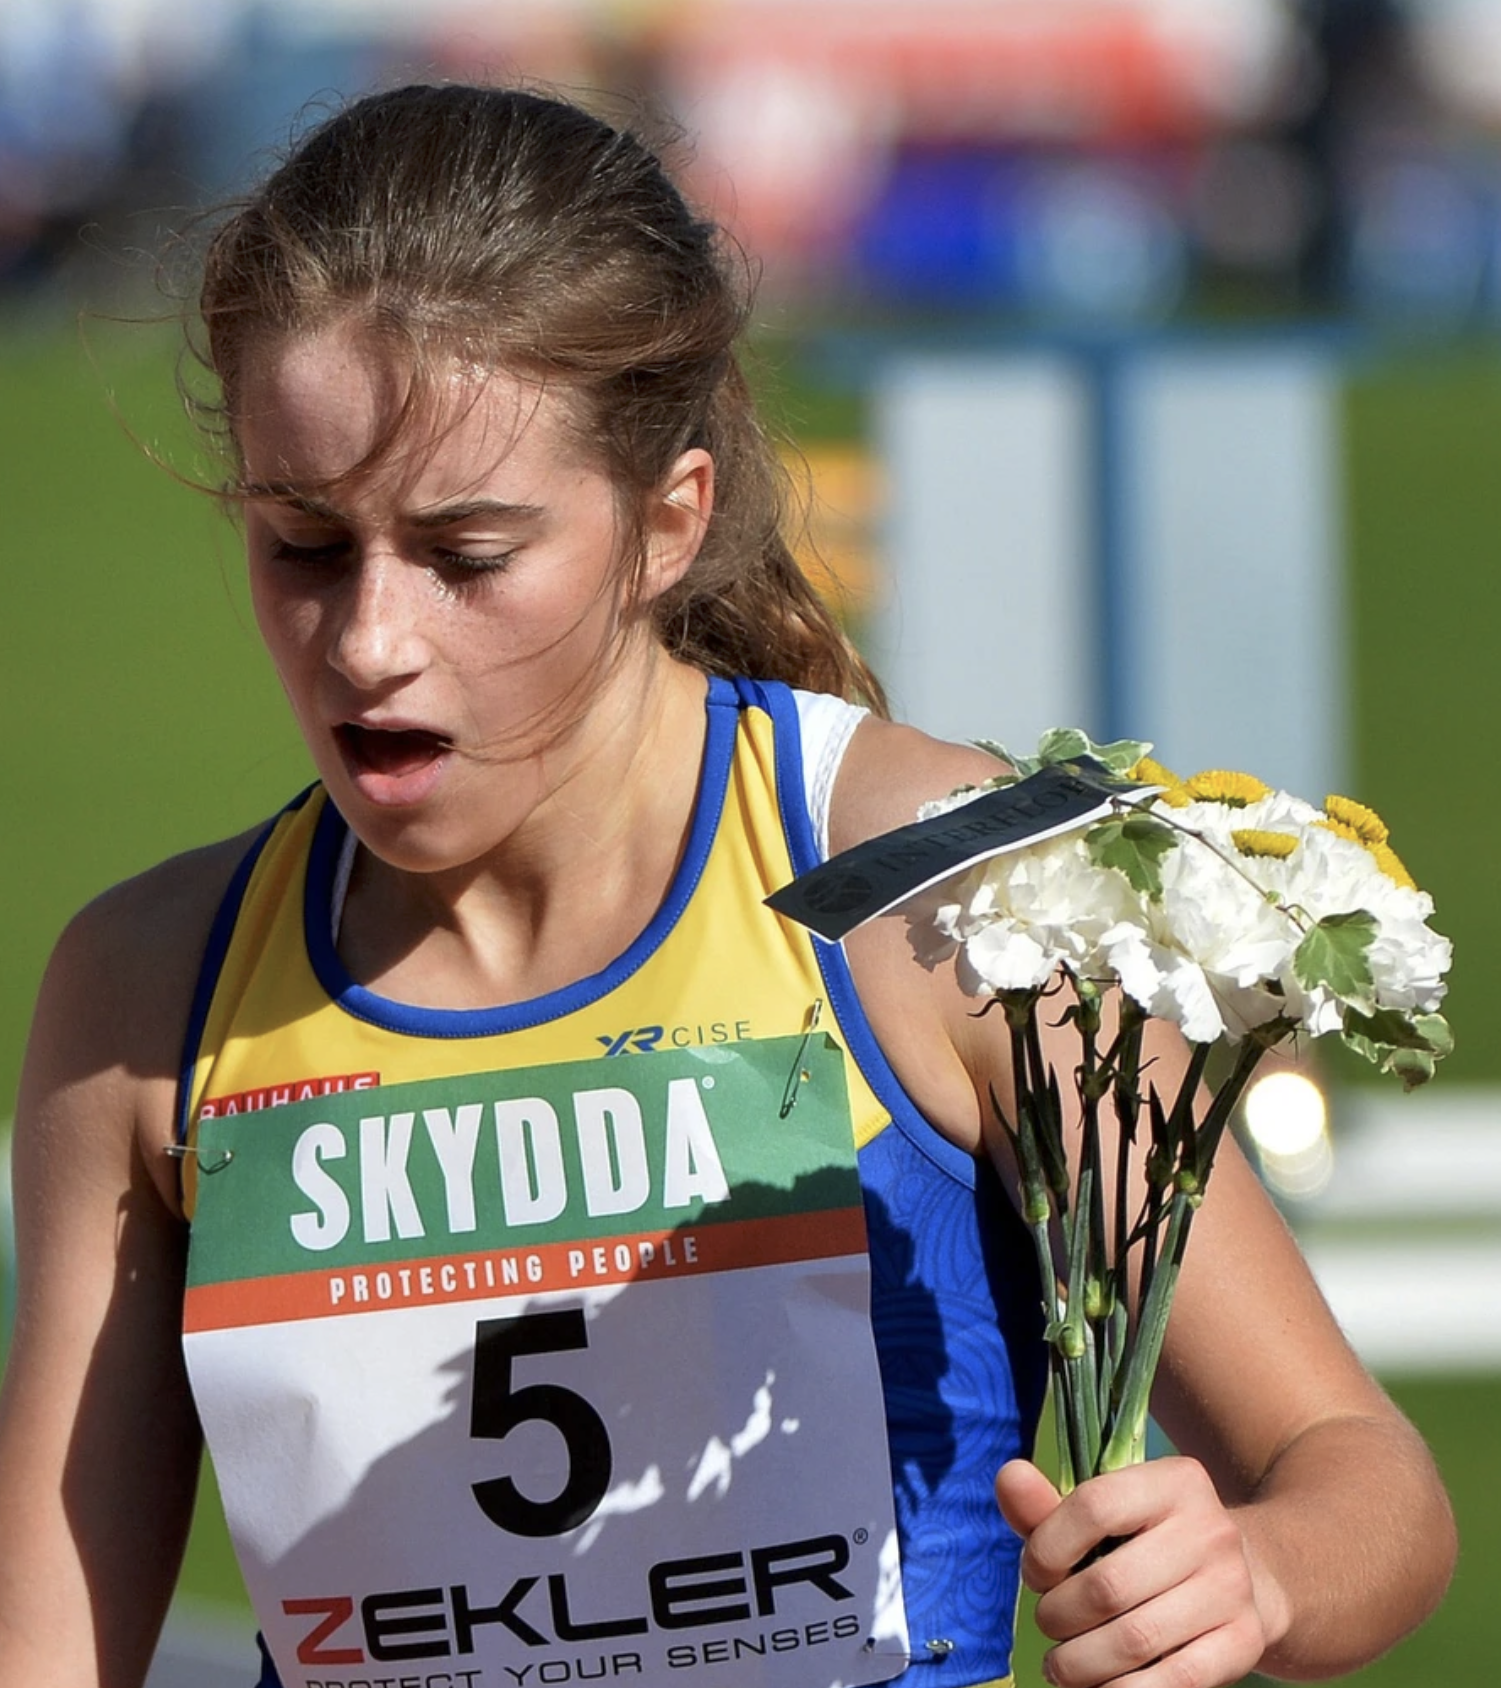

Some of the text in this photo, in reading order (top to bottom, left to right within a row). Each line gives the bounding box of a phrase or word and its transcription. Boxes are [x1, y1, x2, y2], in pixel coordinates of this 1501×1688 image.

[330, 1236, 698, 1304] PROTECTING PEOPLE
[469, 1307, 612, 1538] 5
[504, 1652, 643, 1687] YOUR
[666, 1614, 861, 1669] SENSES
